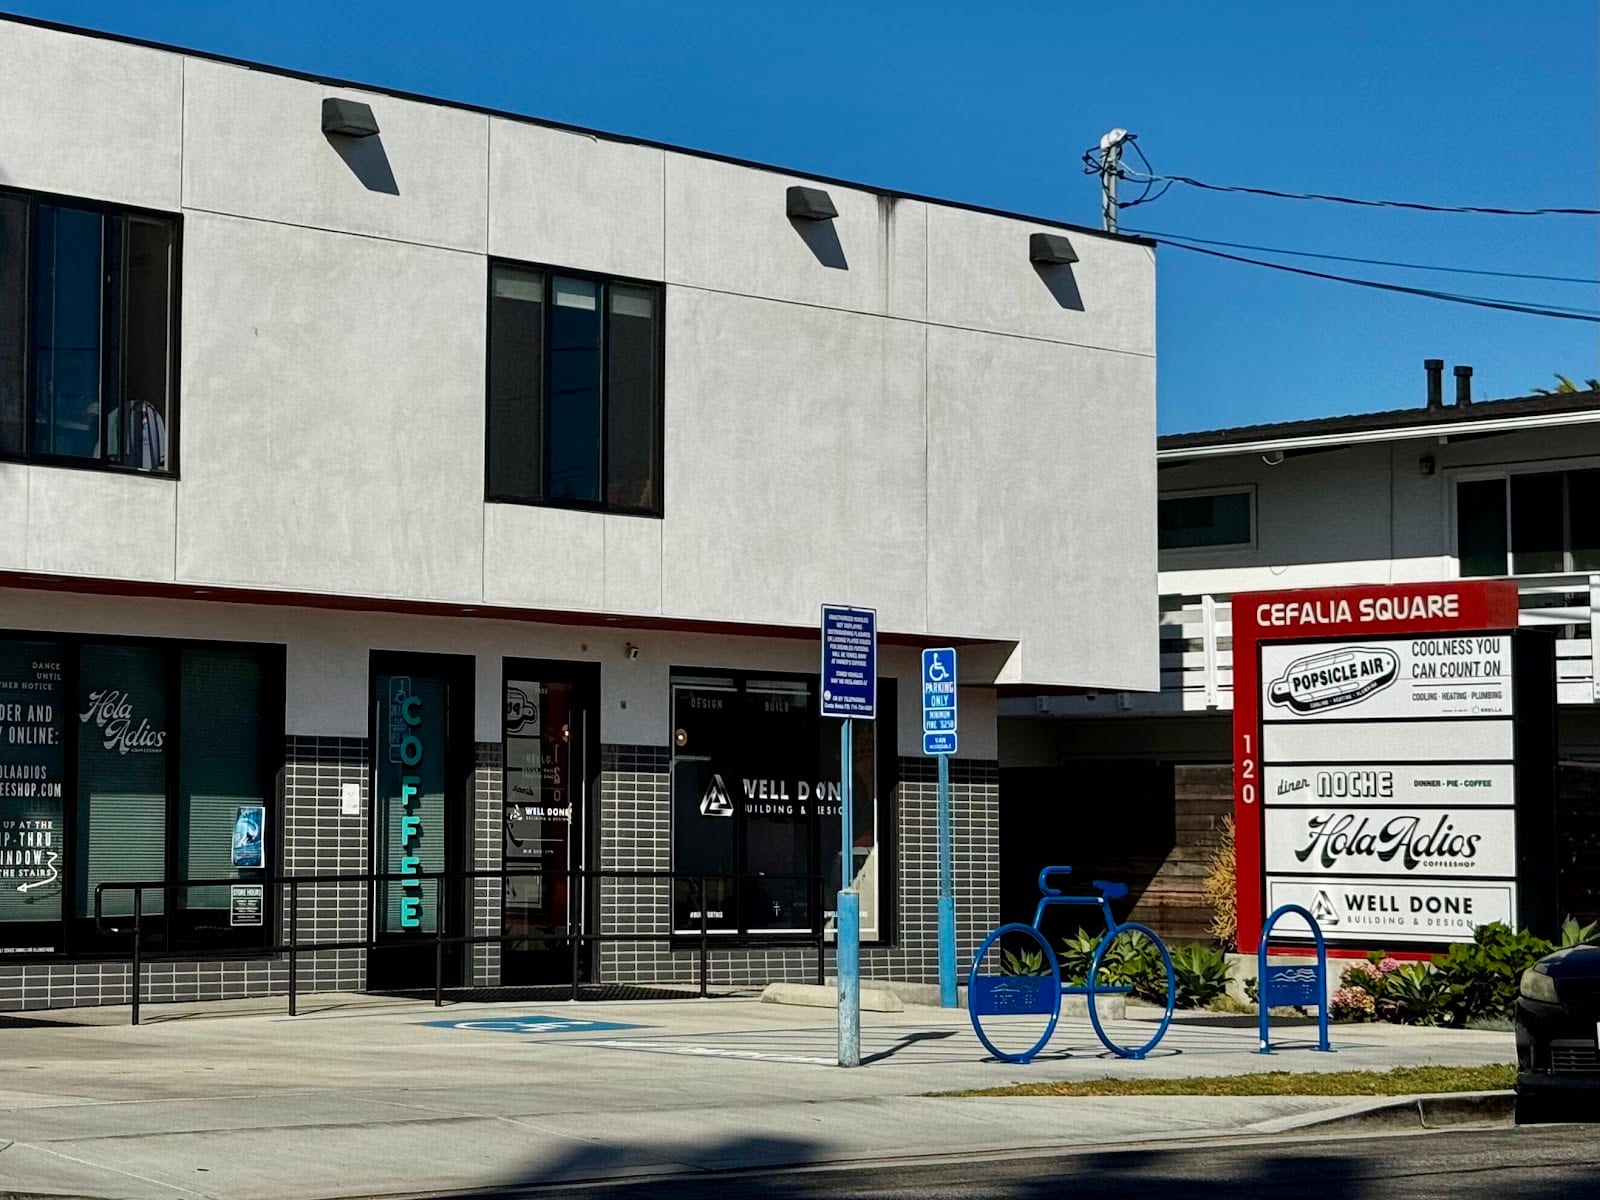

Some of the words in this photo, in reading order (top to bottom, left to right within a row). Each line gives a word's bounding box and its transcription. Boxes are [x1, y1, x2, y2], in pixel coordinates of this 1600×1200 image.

[1257, 600, 1353, 627] CEFALIA
[1359, 594, 1460, 622] SQUARE
[1412, 639, 1474, 657] COOLNESS
[1476, 638, 1500, 655] YOU
[32, 662, 61, 670] DANCE
[1292, 663, 1358, 692] POPSICLE
[1360, 657, 1384, 677] AIR
[1412, 662, 1436, 679] CAN
[1440, 661, 1481, 678] COUNT
[1484, 660, 1501, 677] ON
[37, 672, 62, 681] UNTIL
[926, 681, 954, 694] PARKING
[1412, 692, 1438, 701] COOLING
[1441, 691, 1468, 701] HEATING
[1471, 690, 1502, 700] PLUMBING
[79, 690, 134, 728] Hola
[691, 697, 724, 710] DESIGN
[931, 694, 949, 707] ONLY
[27, 704, 53, 723] AND
[9, 726, 60, 745] ONLINE:
[103, 718, 167, 755] Adios
[1242, 734, 1255, 804] 120
[743, 778, 790, 801] WELL
[797, 780, 842, 801] DON
[1277, 778, 1311, 796] diner
[1317, 771, 1393, 798] NOCHE
[1413, 779, 1441, 788] DINNER
[1446, 779, 1459, 788] PIE
[1464, 779, 1492, 788] COFFEE
[401, 695, 423, 927] COFFEE
[525, 807, 545, 816] WELL
[745, 803, 794, 815] UILDING
[3, 821, 16, 830] UP
[19, 821, 32, 830] AT
[35, 820, 54, 830] THE
[1294, 812, 1377, 869] Hola
[1376, 813, 1482, 871] Adios
[18, 869, 51, 877] STAIRS
[1423, 860, 1476, 869] COFFEESHOP
[1345, 893, 1400, 912] WELL
[1410, 896, 1473, 915] DONE
[1347, 915, 1405, 926] BUILDING
[1412, 917, 1419, 926] &
[1427, 918, 1474, 928] DESIGN
